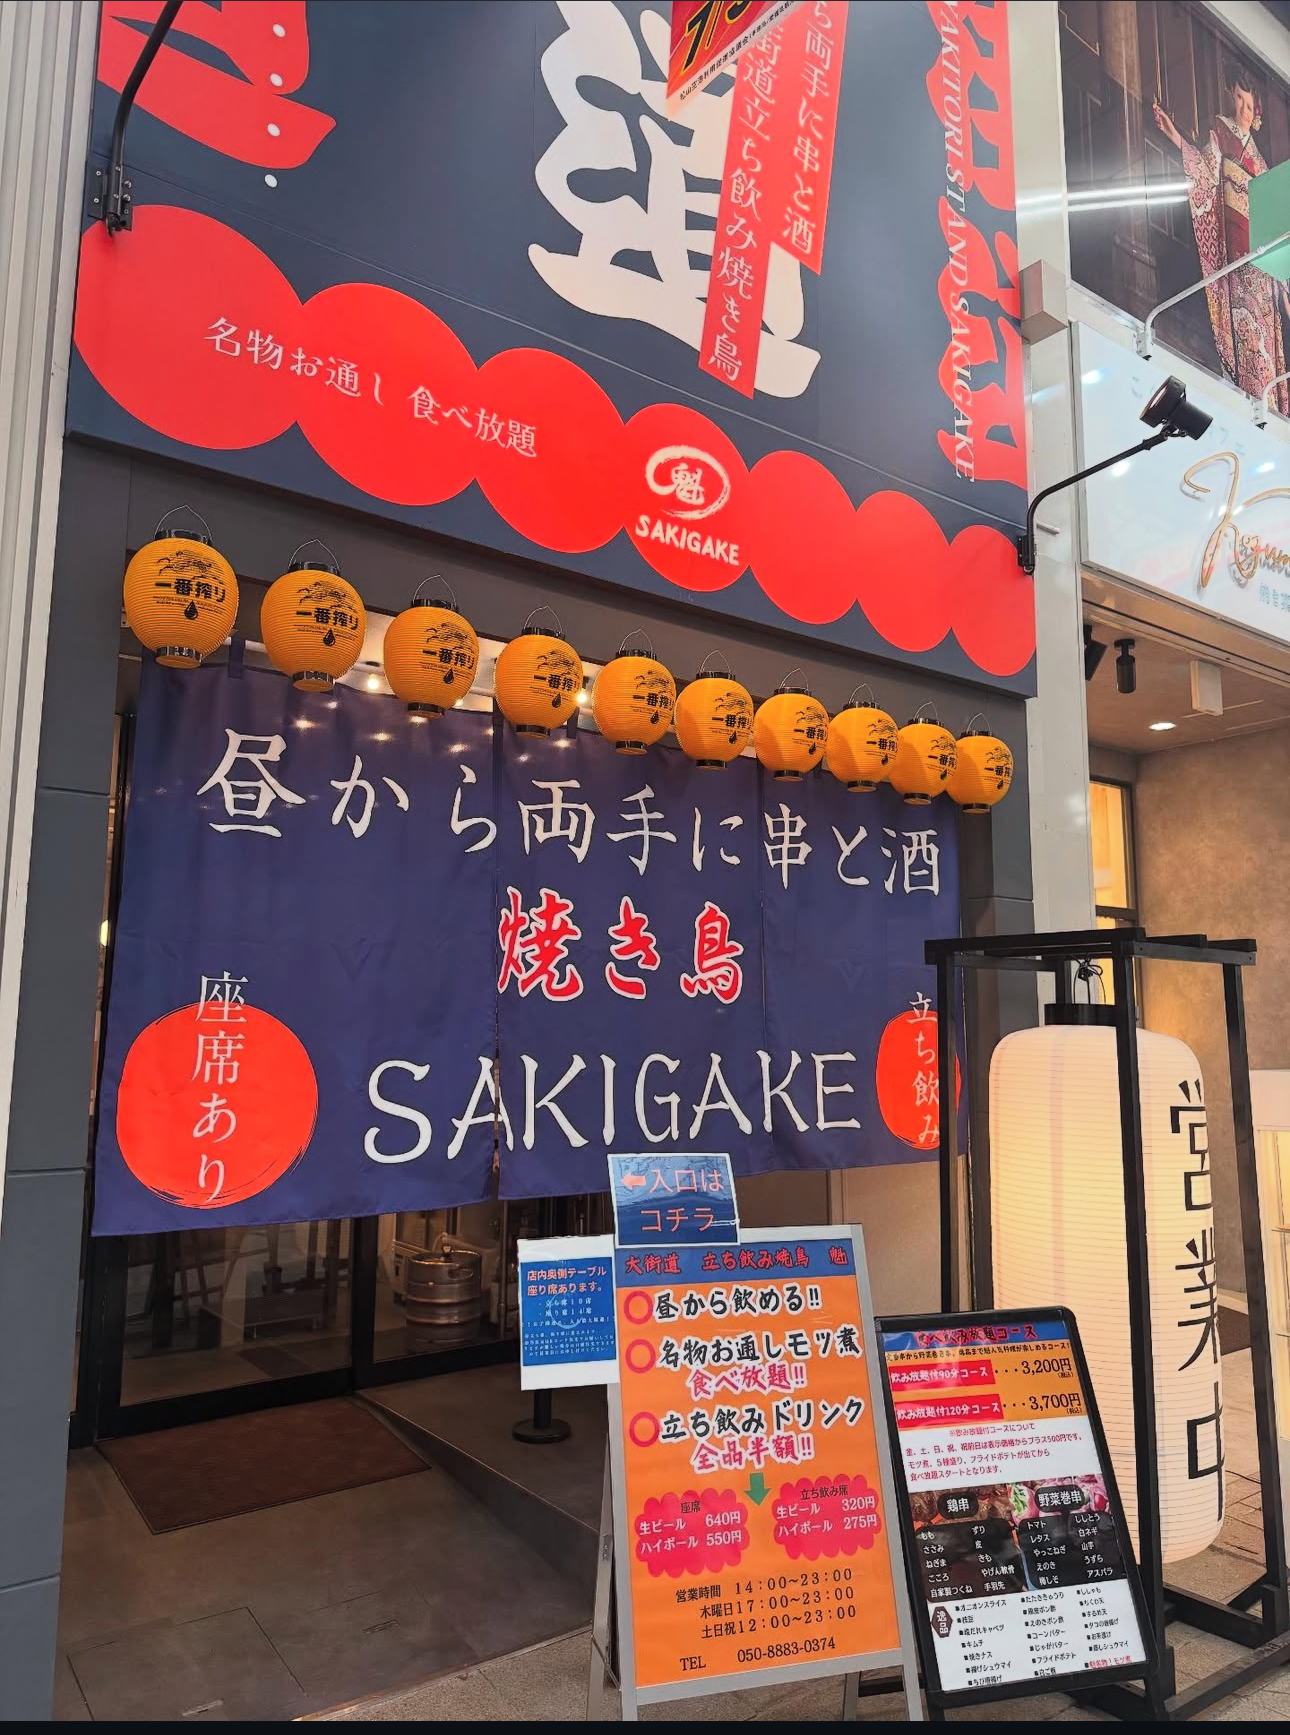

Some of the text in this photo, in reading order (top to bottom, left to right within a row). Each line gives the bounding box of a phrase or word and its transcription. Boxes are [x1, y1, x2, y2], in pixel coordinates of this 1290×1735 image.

[945, 163, 968, 287] STAND
[204, 316, 537, 459] 名物お通し 食べ放題
[950, 291, 975, 482] SAKIGAKE
[635, 514, 740, 566] SAKIGAKE
[155, 578, 226, 603] 一番搾り
[296, 605, 358, 631] 一番搾り
[422, 646, 475, 671] 一番搾り
[197, 728, 939, 896] 昼から両手に串と酒
[498, 886, 744, 1004] 焼き鳥
[191, 971, 249, 1203] 座席あり
[364, 1049, 861, 1163] SAKIGAKE
[648, 1167, 725, 1194] 入口は
[640, 1206, 716, 1234] コチラ
[625, 1246, 849, 1275] 大街道 立ち飲み焼鳥 魁
[527, 1266, 607, 1281] 店内奥側テーブル
[527, 1281, 602, 1296] 座り席あります。
[655, 1285, 820, 1319] 昼から飲める!!
[660, 1326, 861, 1368] 名物お通しモツ煮
[689, 1365, 805, 1397] 食べ放題!!
[890, 1366, 988, 1383] 飲み放題付90分コース
[661, 1398, 863, 1440] 立ち飲みドリンク
[896, 1402, 1000, 1420] 飲み放題付120分コース
[693, 1434, 812, 1470] 全品半額!!
[800, 1484, 849, 1500] 立ち飲み席
[1038, 1491, 1082, 1506] 野菜巻串
[680, 1500, 701, 1514] 座席
[776, 1496, 876, 1519] 生ビール 320円
[639, 1511, 741, 1536] 生ビール 640円
[777, 1514, 878, 1537] ハイボール 275円
[1027, 1521, 1047, 1530] トマト
[1074, 1514, 1100, 1523] ししとう
[920, 1531, 935, 1540] もも
[1030, 1534, 1050, 1543] レタス
[1078, 1528, 1098, 1537] 白ネギ
[640, 1530, 742, 1554] ハイボール 550円
[923, 1545, 944, 1553] ささみ
[1033, 1546, 1066, 1556] やっこねぎ
[926, 1560, 947, 1568] ねぎま
[1036, 1562, 1056, 1571] えのき
[1084, 1555, 1104, 1564] うずら
[928, 1574, 949, 1582] こころ
[981, 1566, 1015, 1576] やげん軟骨
[1087, 1568, 1113, 1578] アスパラ
[675, 1585, 721, 1603] 営業時間
[930, 1585, 973, 1597] 自家製つくね
[984, 1582, 1005, 1591] 手羽先
[960, 1599, 1007, 1612] オニオンスライス
[1032, 1629, 1066, 1639] コーンバター
[966, 1639, 984, 1648] キムチ
[680, 1636, 836, 1671] TEL 050-8883-0374
